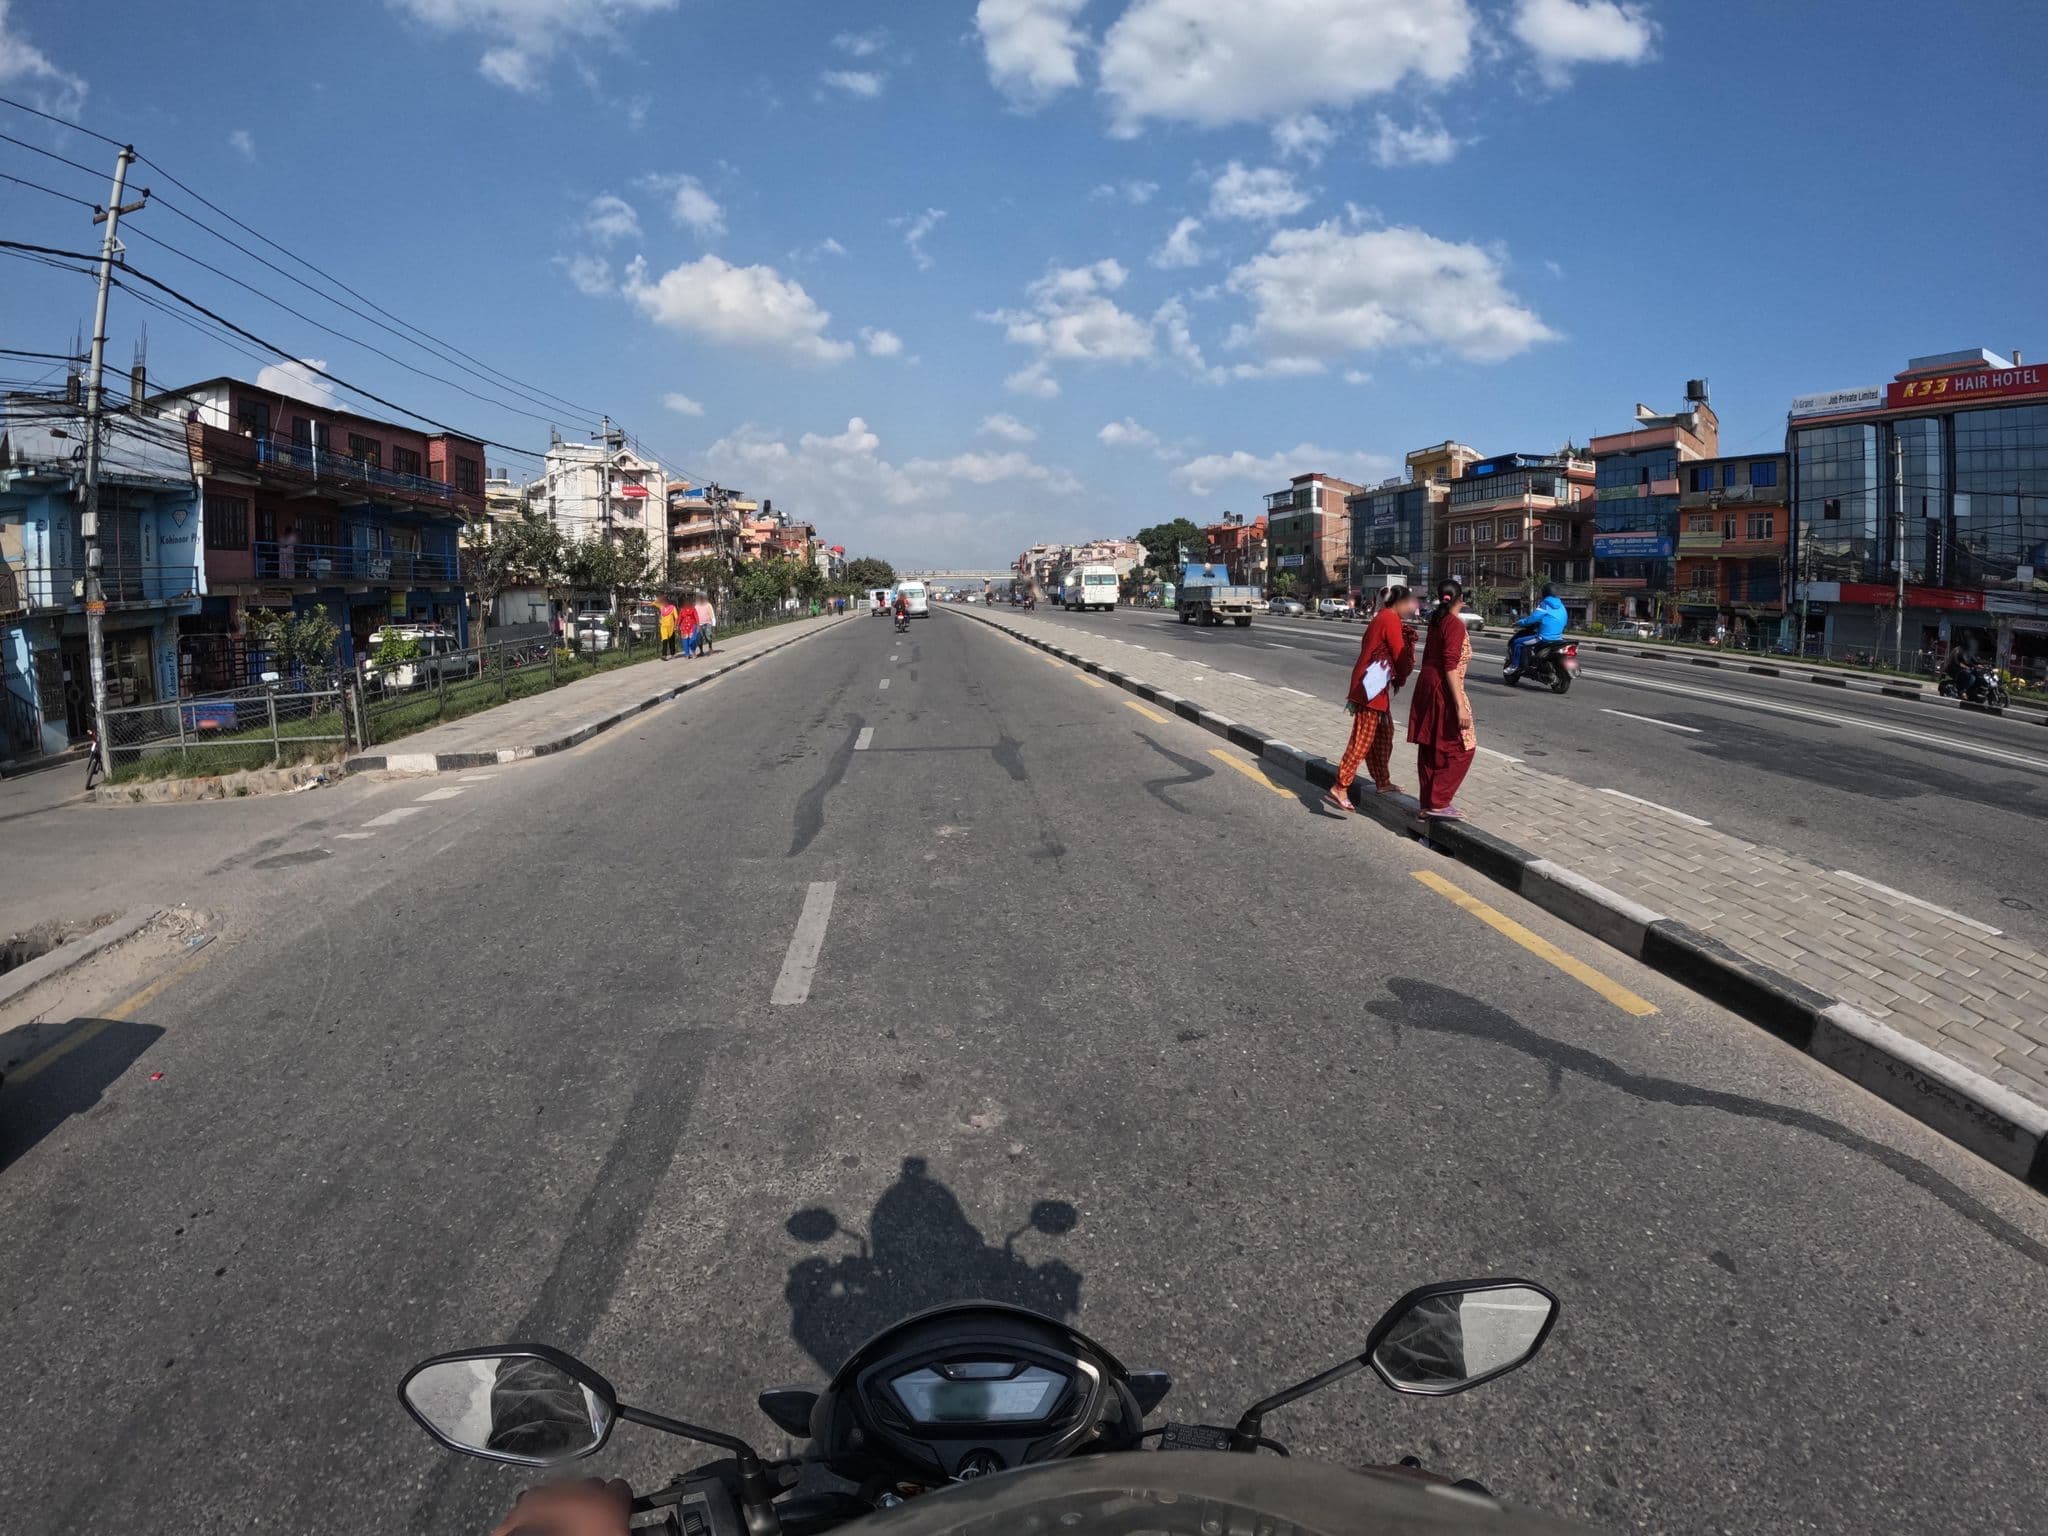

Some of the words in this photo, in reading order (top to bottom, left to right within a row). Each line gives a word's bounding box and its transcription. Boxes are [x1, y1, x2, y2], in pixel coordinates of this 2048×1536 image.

[1955, 376, 1988, 391] HAIR
[1993, 369, 2041, 388] HOTEL
[1839, 393, 1857, 403] Private
[1859, 390, 1879, 401] Limited
